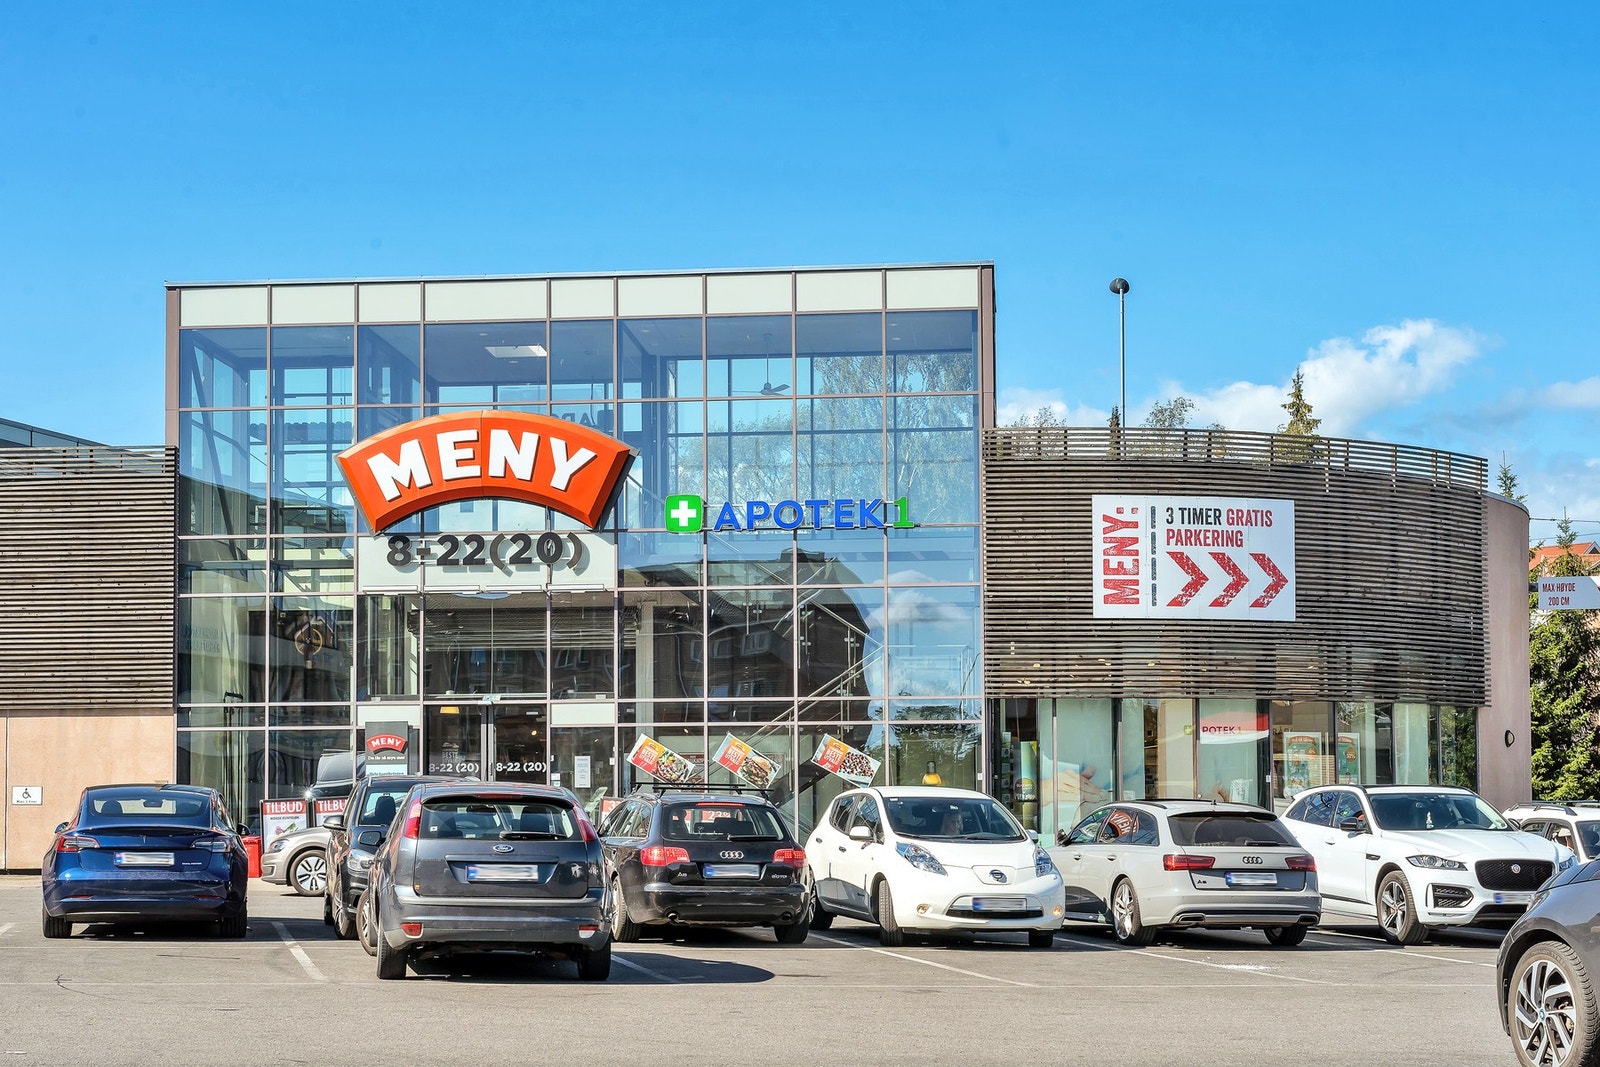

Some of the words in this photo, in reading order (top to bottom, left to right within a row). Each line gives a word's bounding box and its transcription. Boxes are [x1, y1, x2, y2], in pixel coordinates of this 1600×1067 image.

[366, 429, 598, 502] MENY
[713, 498, 885, 531] APOTEK
[893, 496, 914, 527] 1
[1166, 507, 1174, 525] 3
[1178, 507, 1222, 526] TIMER
[1226, 508, 1273, 528] GRATIS
[1166, 528, 1244, 548] PARKERING
[1542, 583, 1555, 592] MAX
[1556, 582, 1576, 592] HØYDE
[1548, 597, 1559, 606] 200
[1561, 596, 1570, 605] CM
[371, 737, 402, 748] MENY
[429, 763, 453, 772] 8-22
[456, 763, 480, 773] (20)
[496, 763, 521, 772] 8-22
[523, 762, 547, 773] (20)
[265, 801, 303, 813] TILBUD
[317, 799, 348, 812] TILBU
